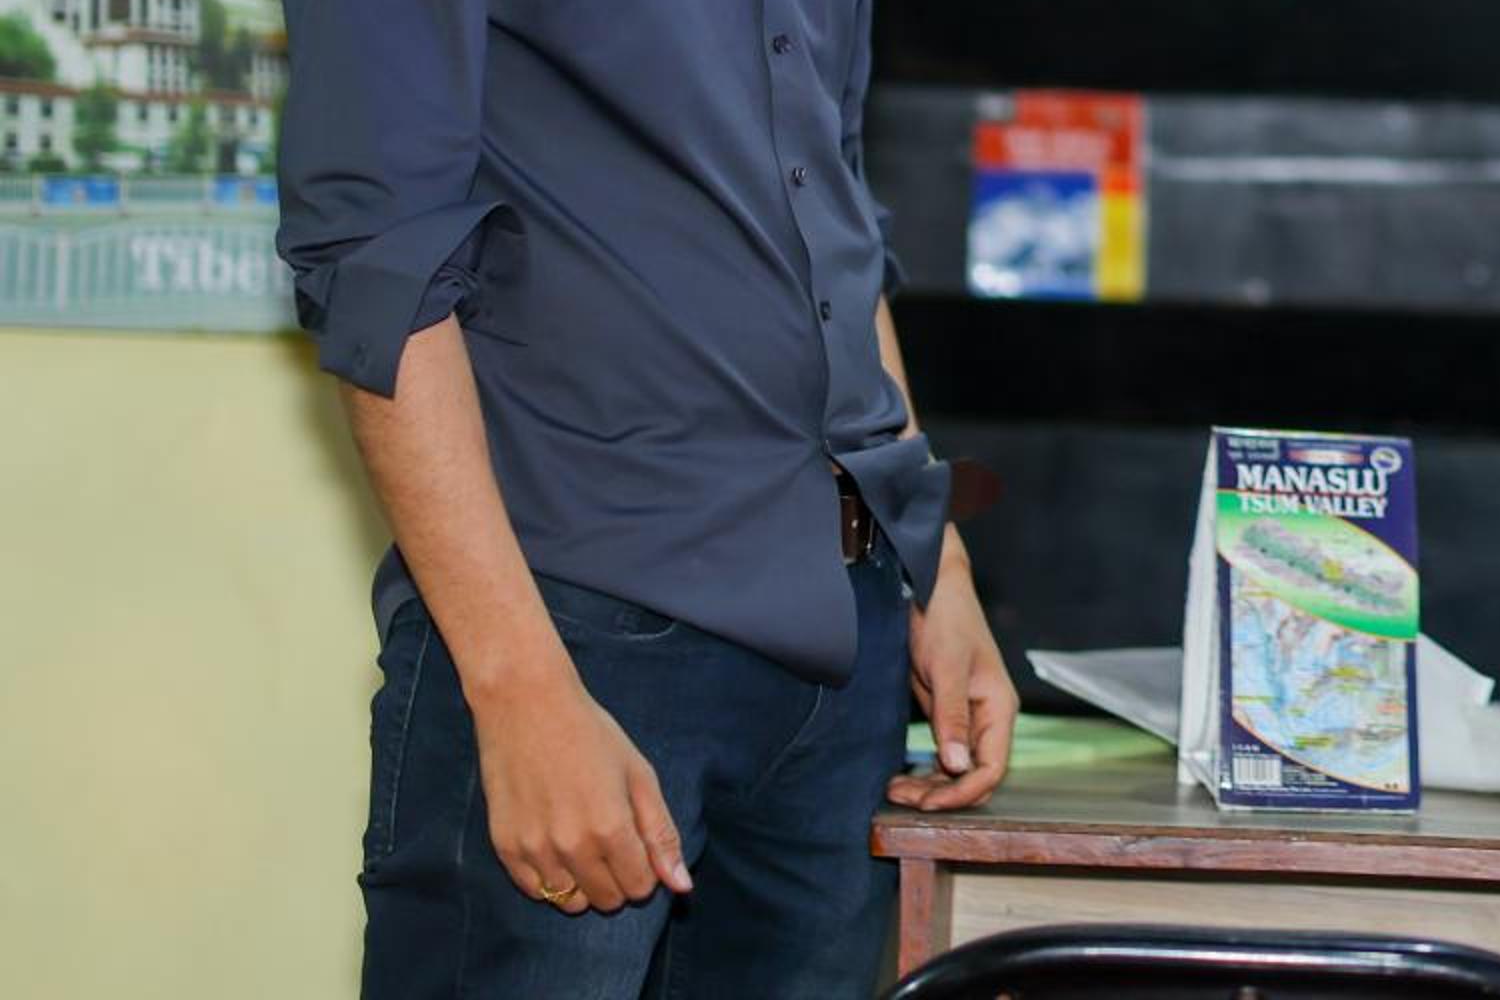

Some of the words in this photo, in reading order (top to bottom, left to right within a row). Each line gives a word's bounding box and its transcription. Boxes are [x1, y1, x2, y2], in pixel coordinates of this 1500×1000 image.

[1238, 465, 1387, 495] MANASLU
[1239, 495, 1299, 513] TSUM
[1305, 496, 1387, 517] VALLEY
